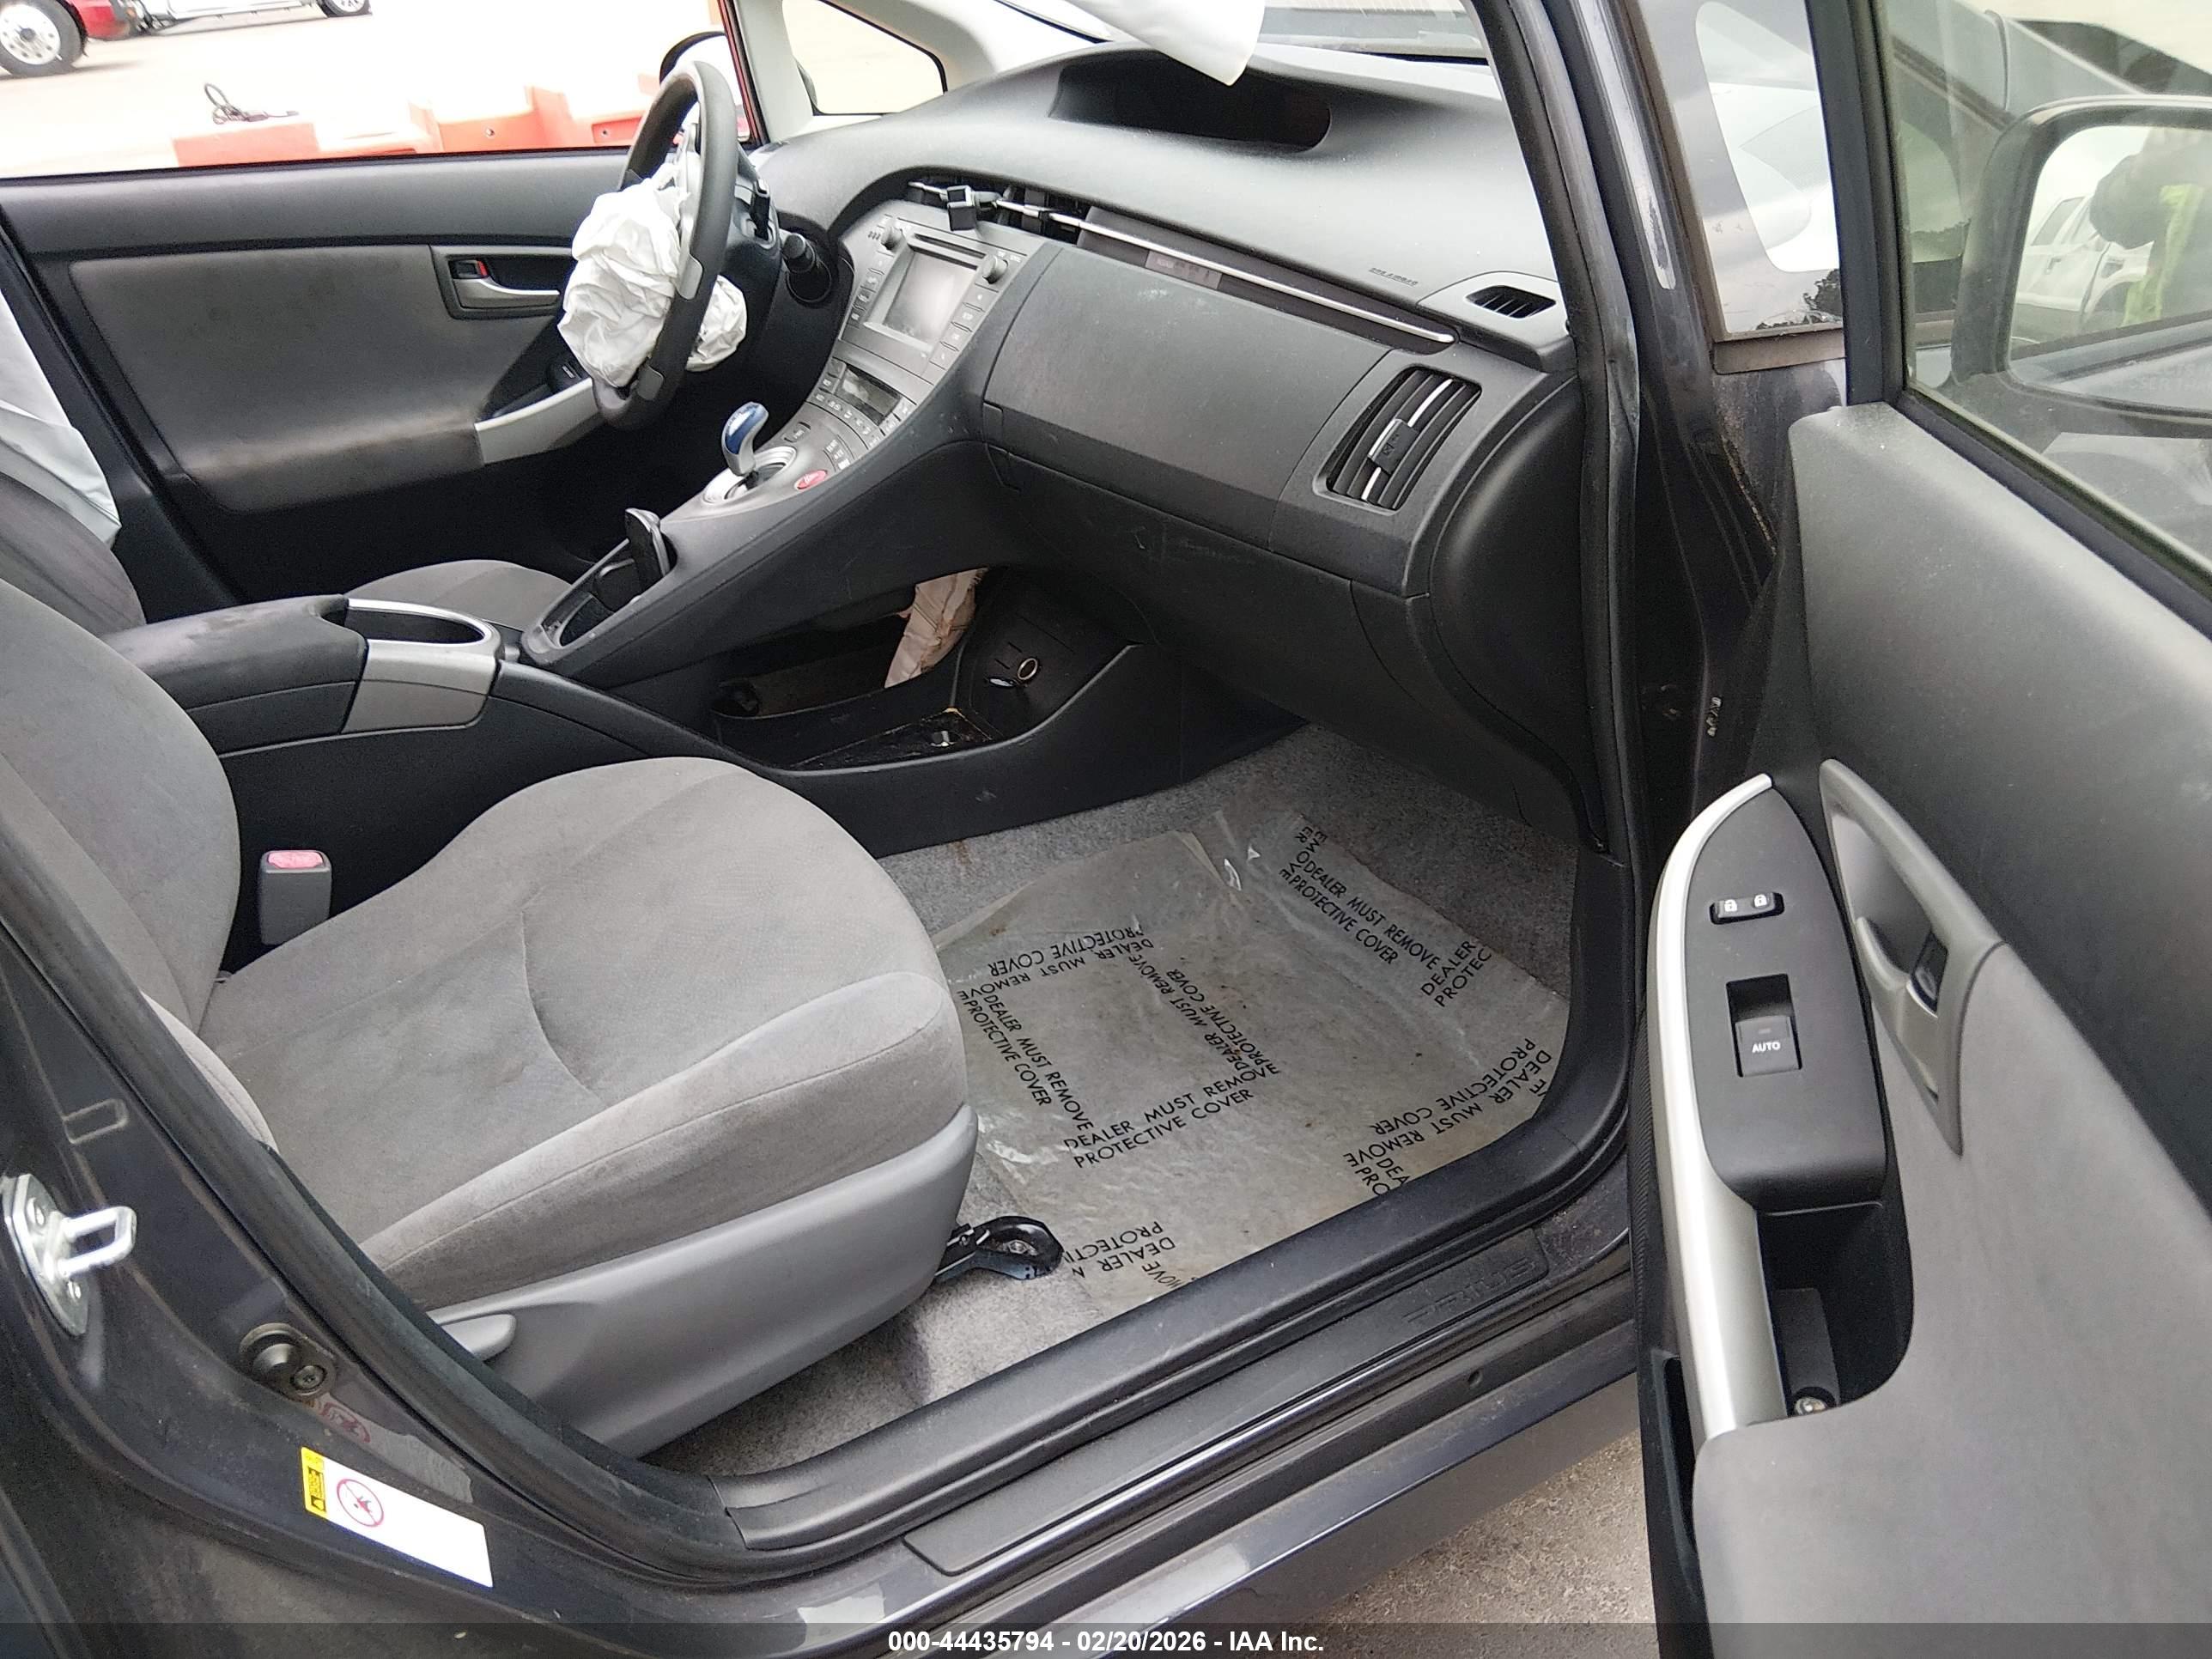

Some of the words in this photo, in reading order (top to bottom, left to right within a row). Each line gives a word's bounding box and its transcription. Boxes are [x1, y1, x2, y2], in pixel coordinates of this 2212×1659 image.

[1288, 876, 1357, 932] PROTECTIVE
[1355, 928, 1399, 964] COVER
[1303, 860, 1346, 898] DEALER
[1346, 896, 1387, 927] MUST
[1384, 924, 1440, 970] REMOVE
[988, 950, 1045, 977] COVER
[1040, 957, 1086, 977] MUST
[1096, 939, 1154, 960] DEALER
[1419, 940, 1477, 996] DEALER
[957, 972, 1031, 1000] REMOVE
[1128, 955, 1175, 994] REMOVE
[1166, 969, 1205, 1002] COVER
[1170, 998, 1208, 1026] MUST
[963, 1000, 1021, 1062] PROTECTIVE
[1014, 1063, 1052, 1106] COVER
[1200, 1005, 1272, 1066] PROTECTIVE
[1203, 1032, 1250, 1071] DEALER
[1752, 1041, 1781, 1053] AUTO
[983, 996, 1022, 1032] DEALER
[1017, 1037, 1053, 1068] MUST
[1045, 1071, 1094, 1131] REMOVE
[1436, 1038, 1536, 1111] PROTECTIVE
[1487, 1049, 1553, 1104] DEALER
[1063, 1121, 1134, 1149] DEALER
[1144, 1093, 1196, 1122] MUST
[1203, 1063, 1280, 1097] REMOVE
[1370, 1108, 1433, 1135] COVER
[1431, 1103, 1483, 1134] MUST
[1073, 1116, 1187, 1168] PROTECTIVE
[1191, 1089, 1254, 1119] COVER
[1343, 1130, 1425, 1167] REMOVE
[1097, 1237, 1176, 1272] DEALER
